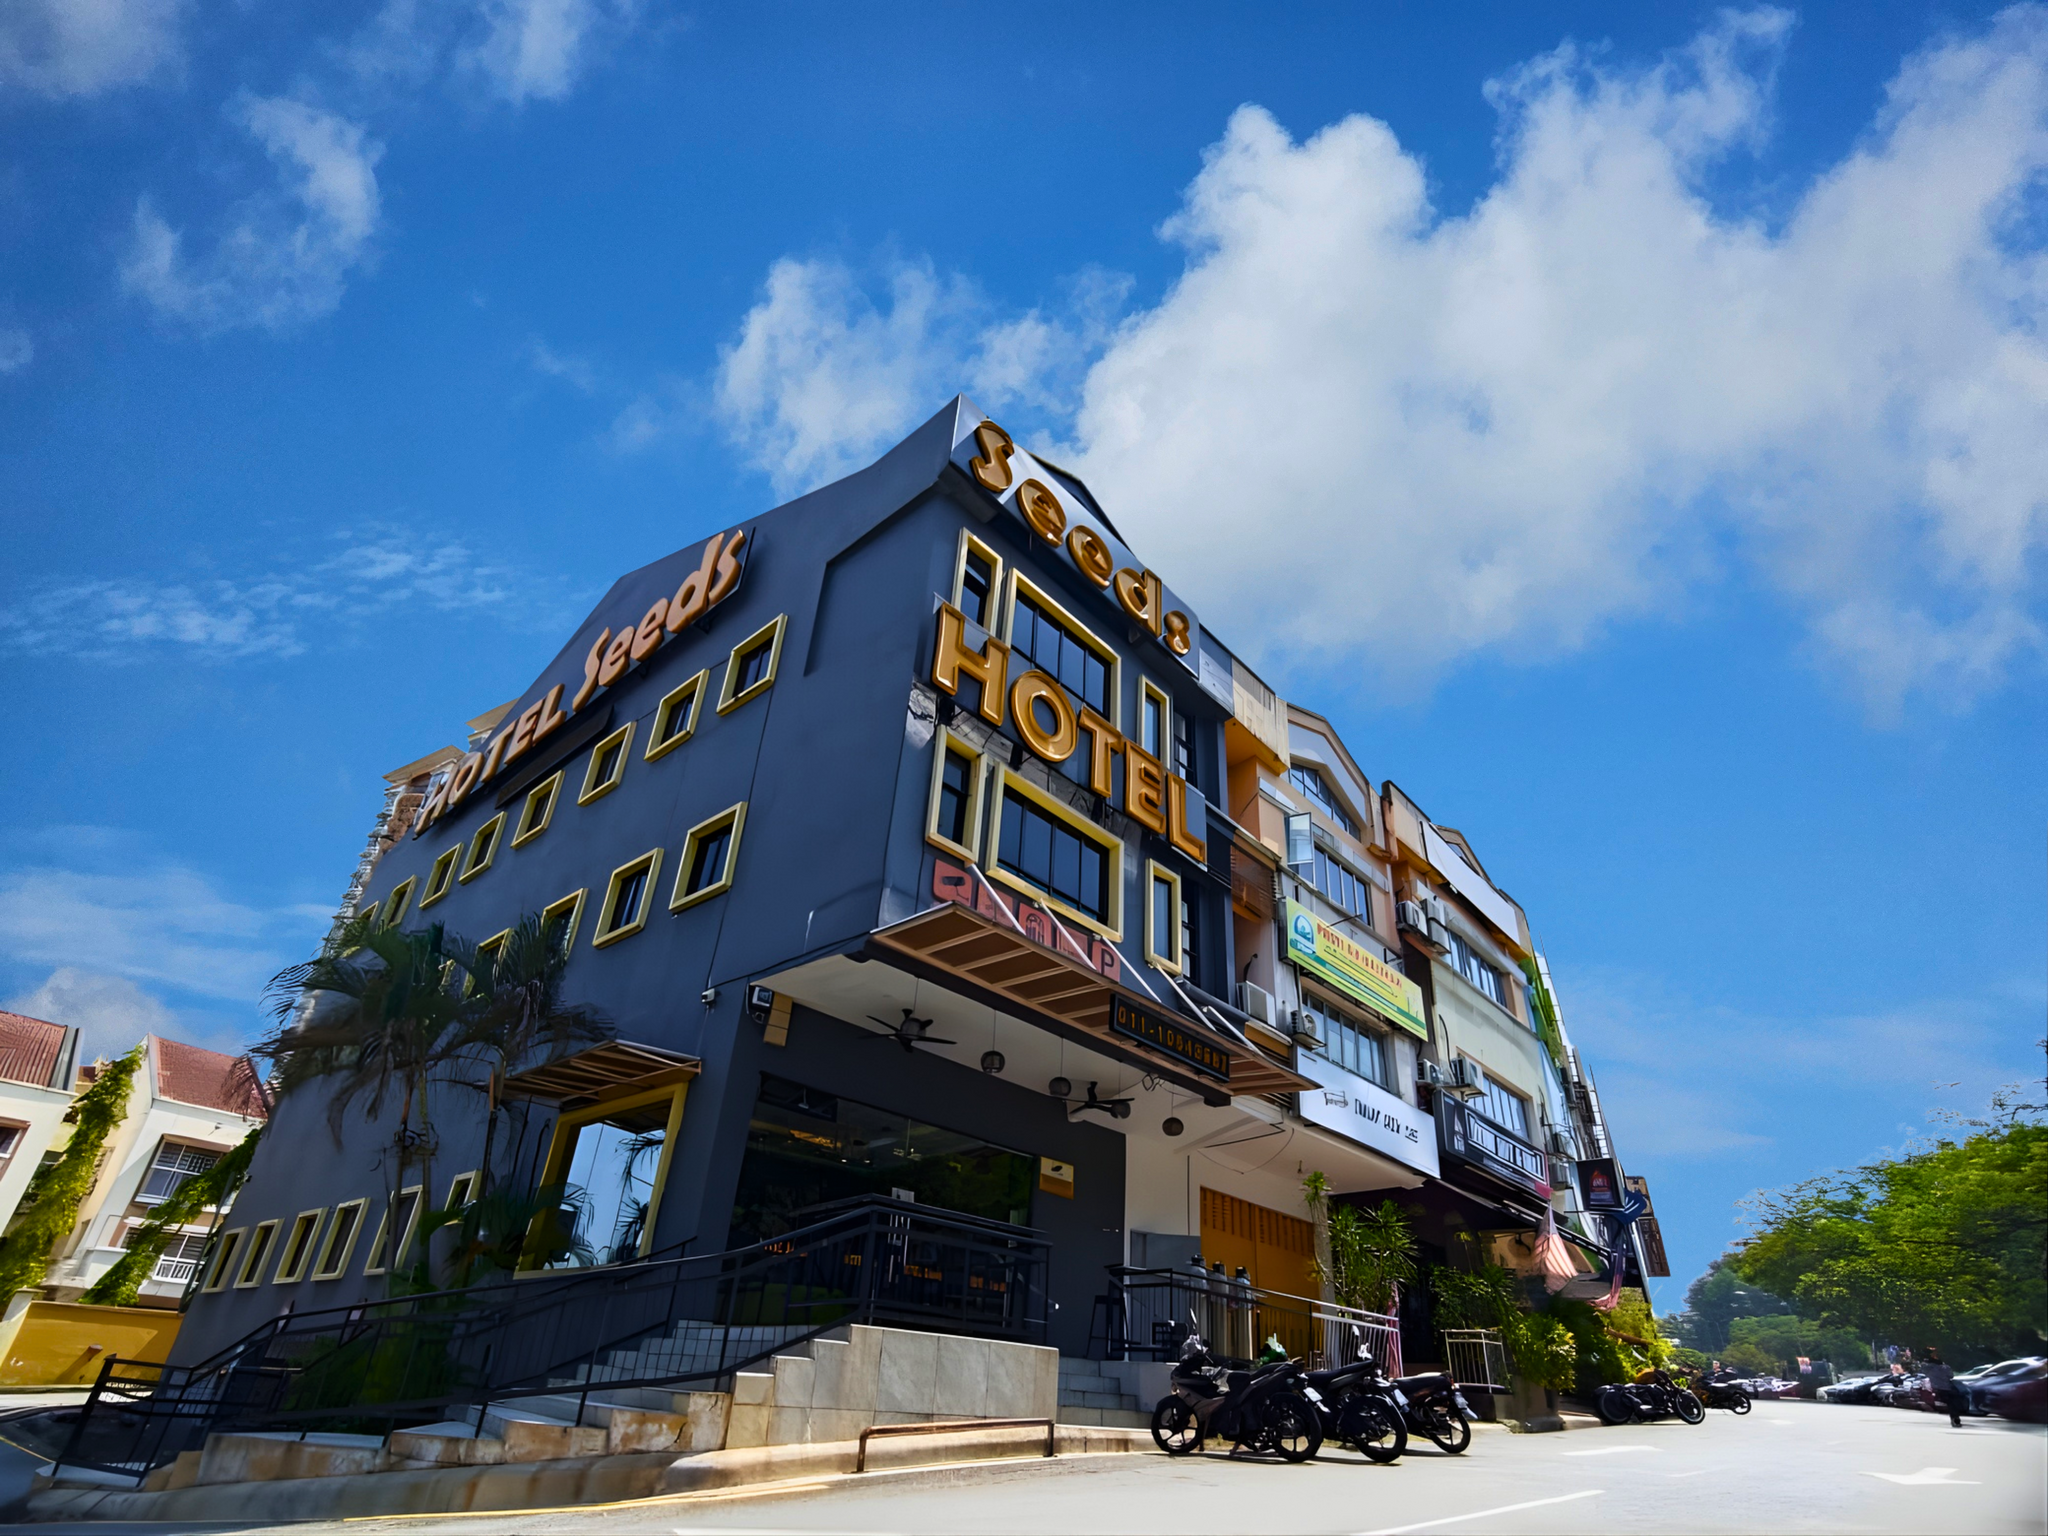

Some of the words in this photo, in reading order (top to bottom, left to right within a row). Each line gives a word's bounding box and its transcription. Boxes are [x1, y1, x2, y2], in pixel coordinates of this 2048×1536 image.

[413, 683, 567, 836] HOTEL
[572, 529, 747, 713] Seeds
[932, 602, 1207, 865] HOTEL
